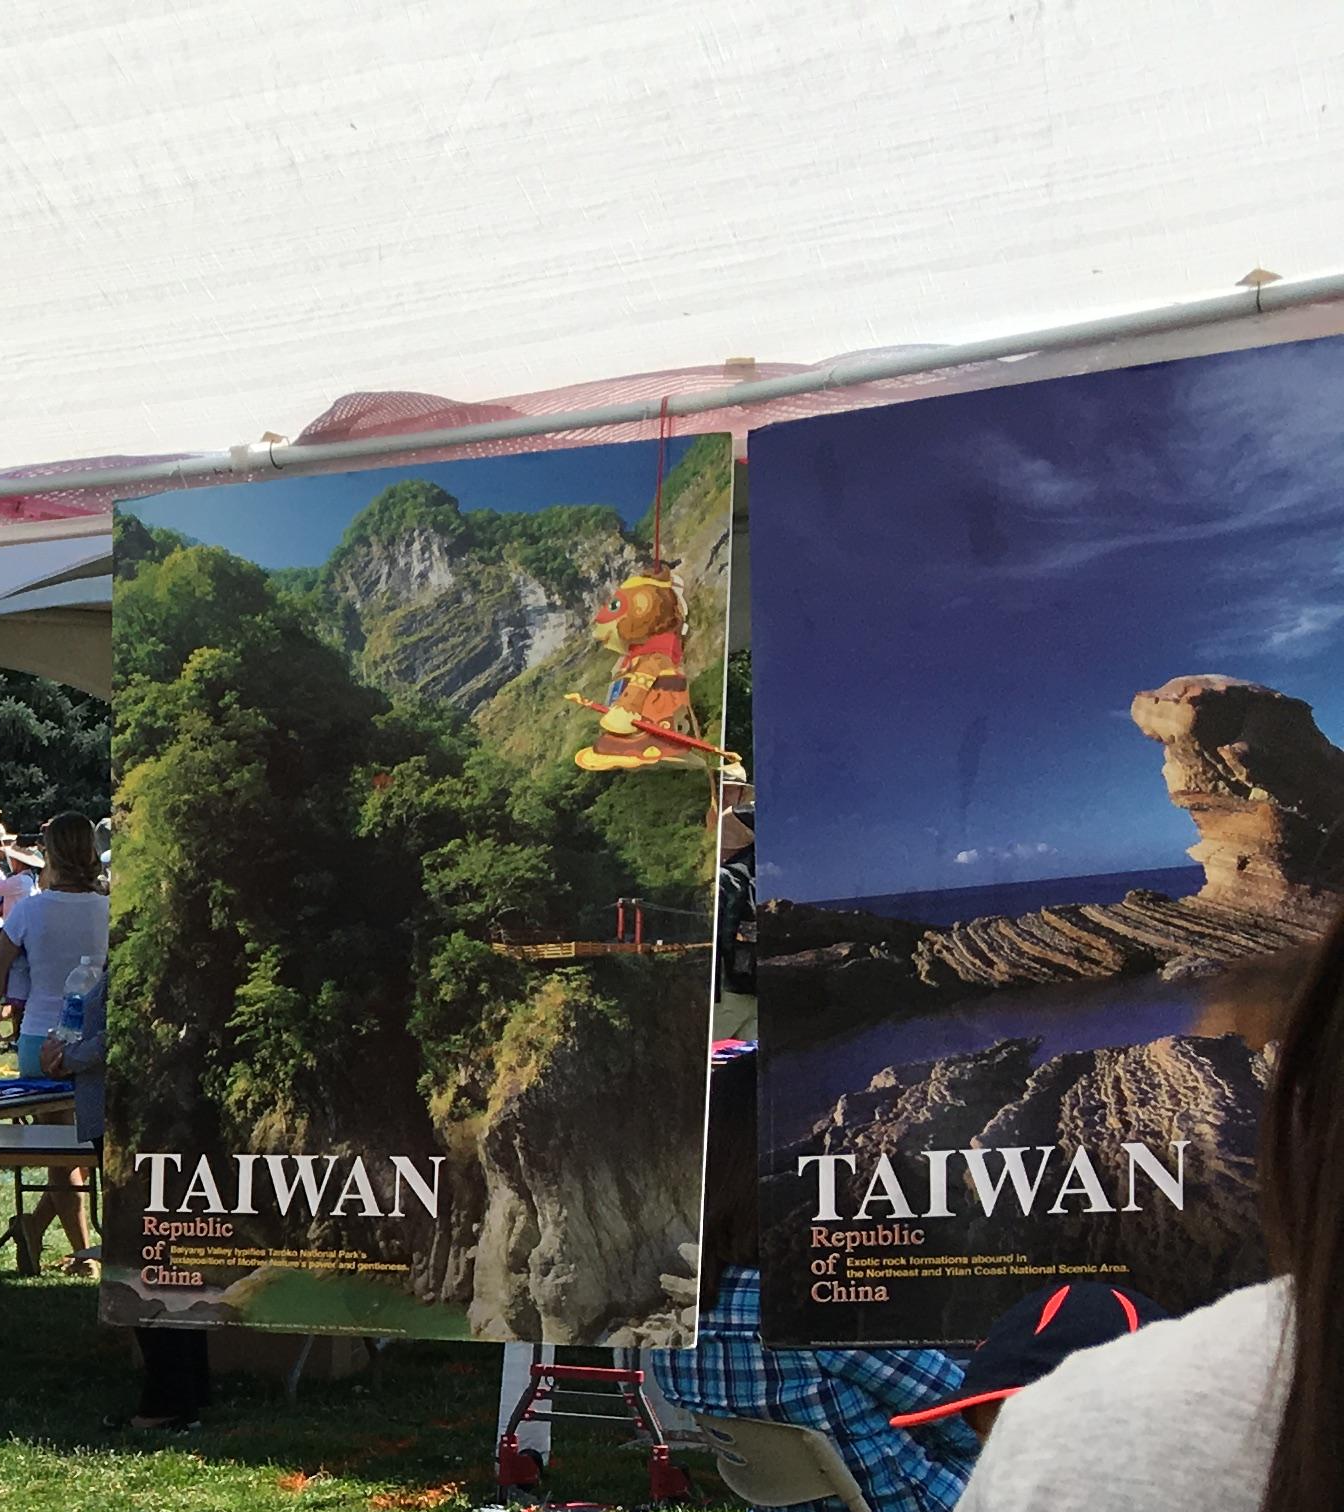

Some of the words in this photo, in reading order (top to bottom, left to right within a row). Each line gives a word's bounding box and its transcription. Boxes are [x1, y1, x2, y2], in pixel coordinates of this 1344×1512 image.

[135, 1153, 446, 1219] TAIWAN
[798, 1140, 1192, 1222] TAIWAN
[142, 1216, 234, 1241] Republic
[810, 1226, 926, 1252] Republic
[142, 1242, 166, 1260] of
[846, 1257, 881, 1267] Exotic
[882, 1256, 906, 1266] rock
[909, 1255, 968, 1265] formations
[971, 1254, 1013, 1264] abound
[1016, 1253, 1027, 1263] in
[811, 1253, 841, 1275] of
[846, 1268, 864, 1278] the
[866, 1267, 919, 1277] Northeast
[921, 1267, 942, 1277] and
[945, 1266, 972, 1276] Yilan
[974, 1266, 1008, 1276] Coast
[1010, 1265, 1056, 1275] National
[1059, 1264, 1097, 1274] Scenic
[1099, 1263, 1130, 1273] Area.
[141, 1265, 203, 1286] China
[811, 1281, 890, 1303] China
